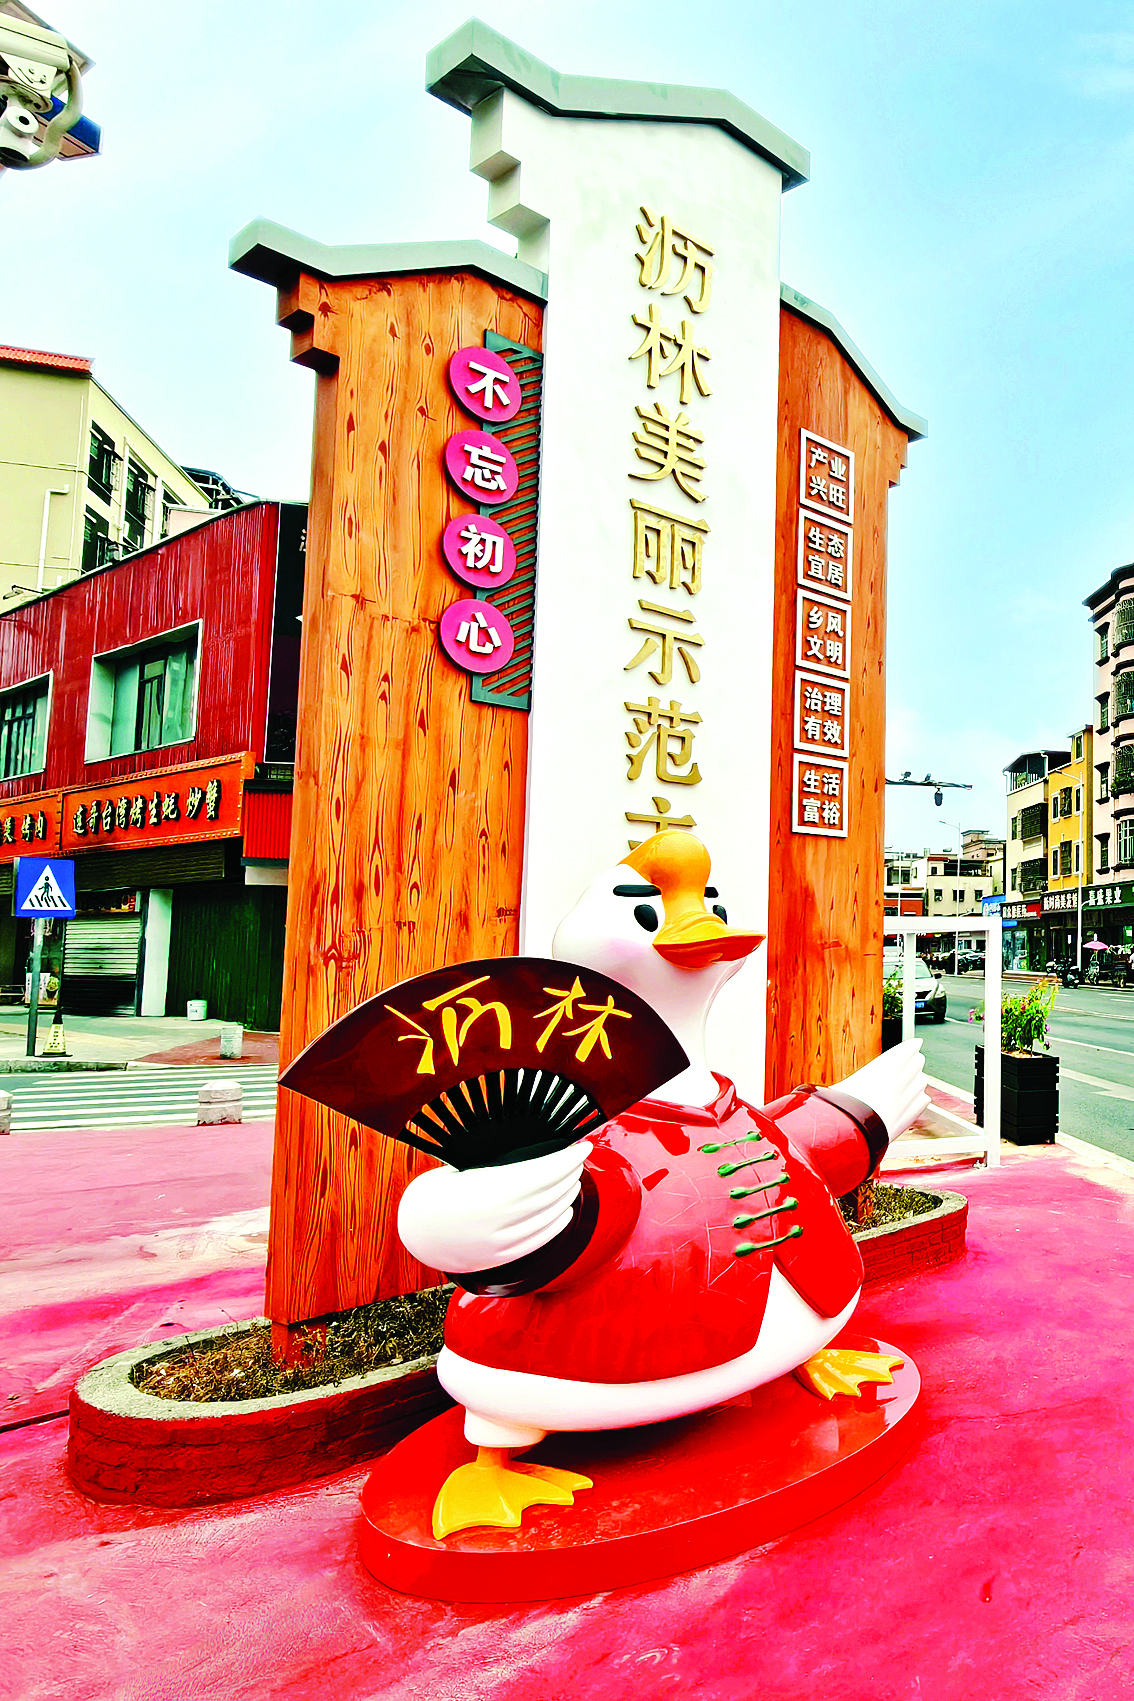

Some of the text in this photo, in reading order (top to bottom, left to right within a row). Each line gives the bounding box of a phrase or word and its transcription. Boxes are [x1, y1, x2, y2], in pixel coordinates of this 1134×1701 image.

[810, 446, 846, 482] 产业
[456, 360, 510, 655] 不忘初心
[809, 475, 846, 510] 兴旺
[807, 525, 845, 559] 生态
[807, 553, 844, 588] 宜居
[807, 604, 844, 638] 乡风
[806, 633, 843, 665] 文明
[804, 684, 843, 718] 治理
[804, 713, 842, 745] 有效
[802, 769, 841, 796] 生活
[802, 796, 841, 826] 富裕
